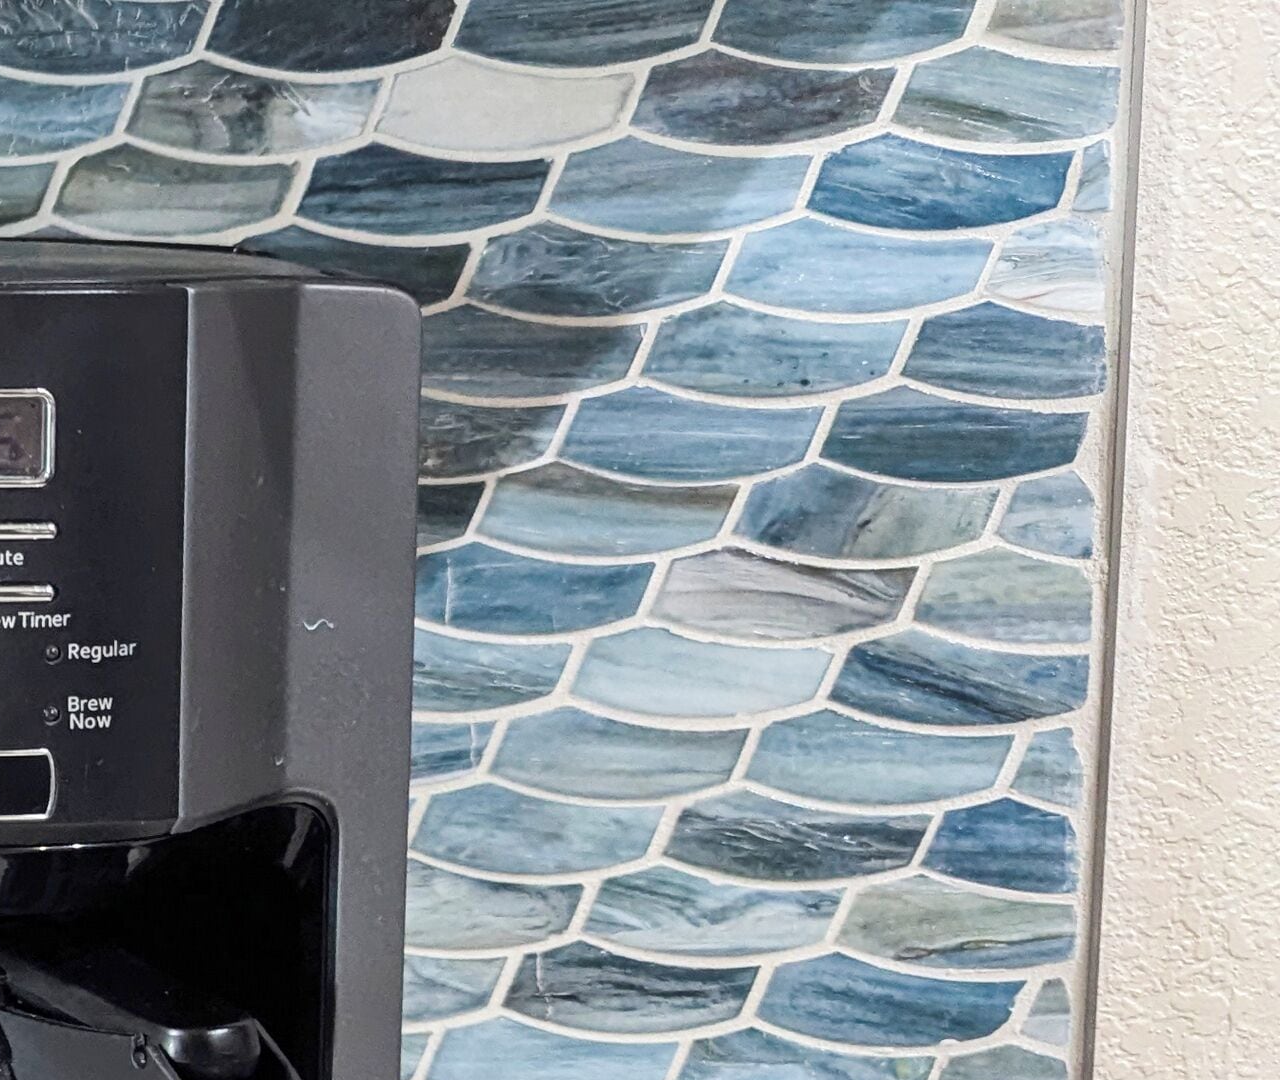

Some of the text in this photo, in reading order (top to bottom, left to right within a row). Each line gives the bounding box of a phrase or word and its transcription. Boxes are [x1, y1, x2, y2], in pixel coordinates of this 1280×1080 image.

[17, 611, 71, 628] Timer
[67, 640, 137, 663] Regular
[67, 696, 113, 712] Brew
[69, 713, 112, 730] Now
